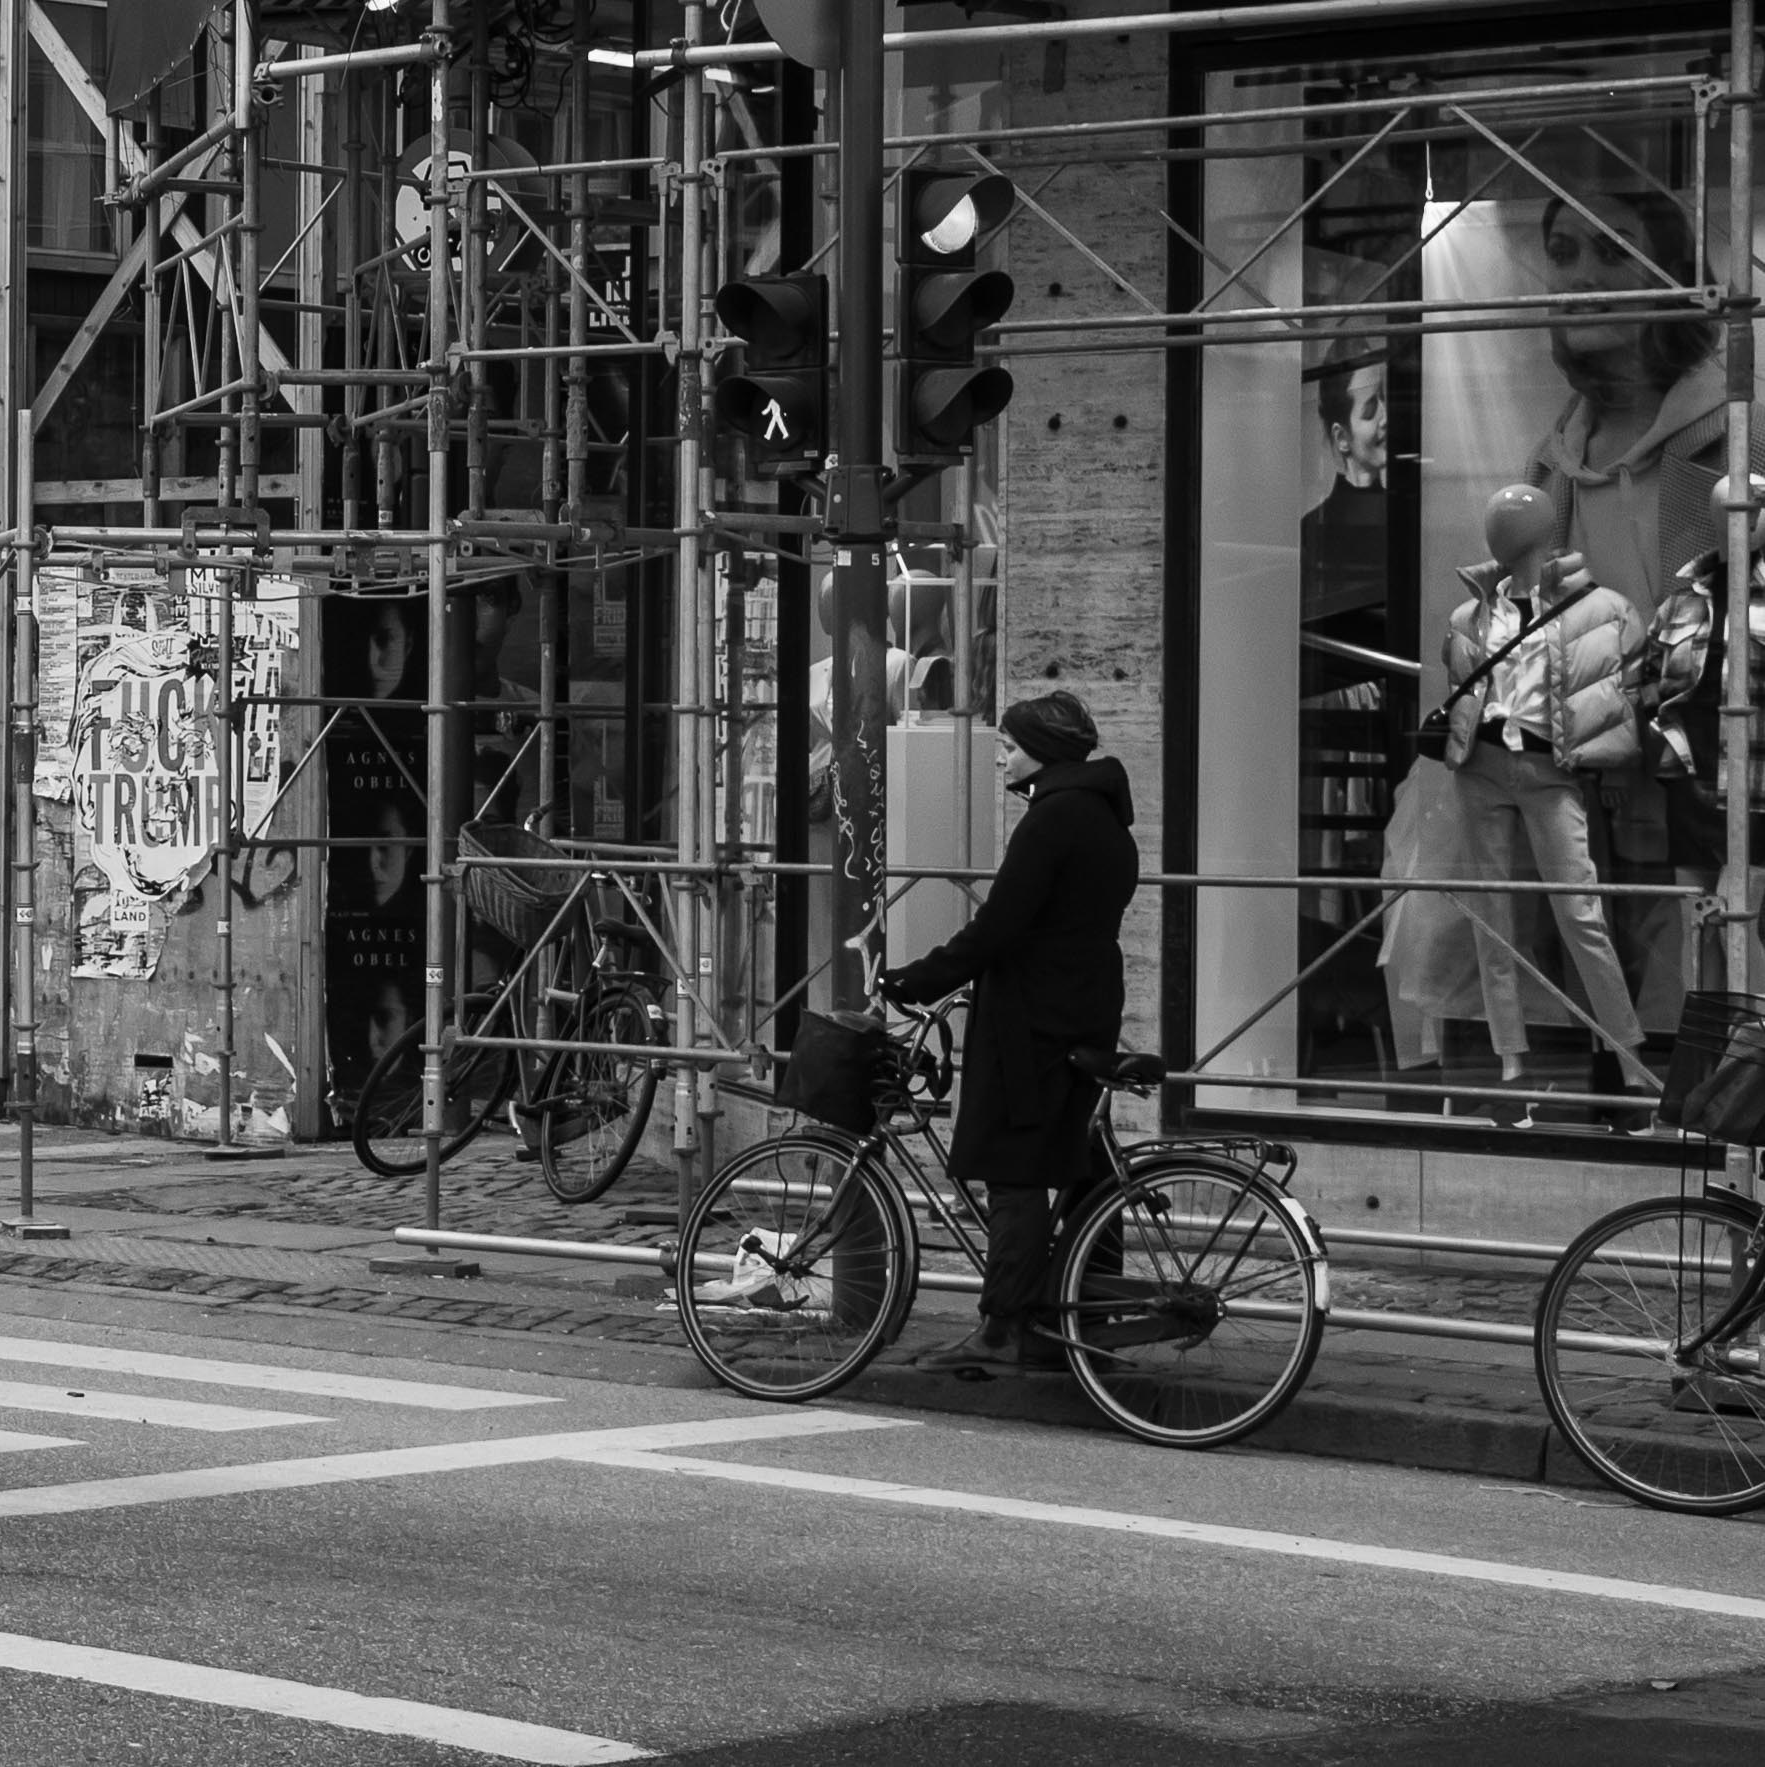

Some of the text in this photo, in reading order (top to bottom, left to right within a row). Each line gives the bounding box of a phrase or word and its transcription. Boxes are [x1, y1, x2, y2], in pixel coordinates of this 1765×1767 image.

[91, 678, 220, 772] FUCK
[346, 751, 416, 765] AGNS
[353, 775, 408, 789] OBEL
[92, 773, 222, 849] TRUMP
[114, 910, 147, 922] LAND
[346, 928, 417, 942] AGNES
[353, 953, 408, 966] OBEL
